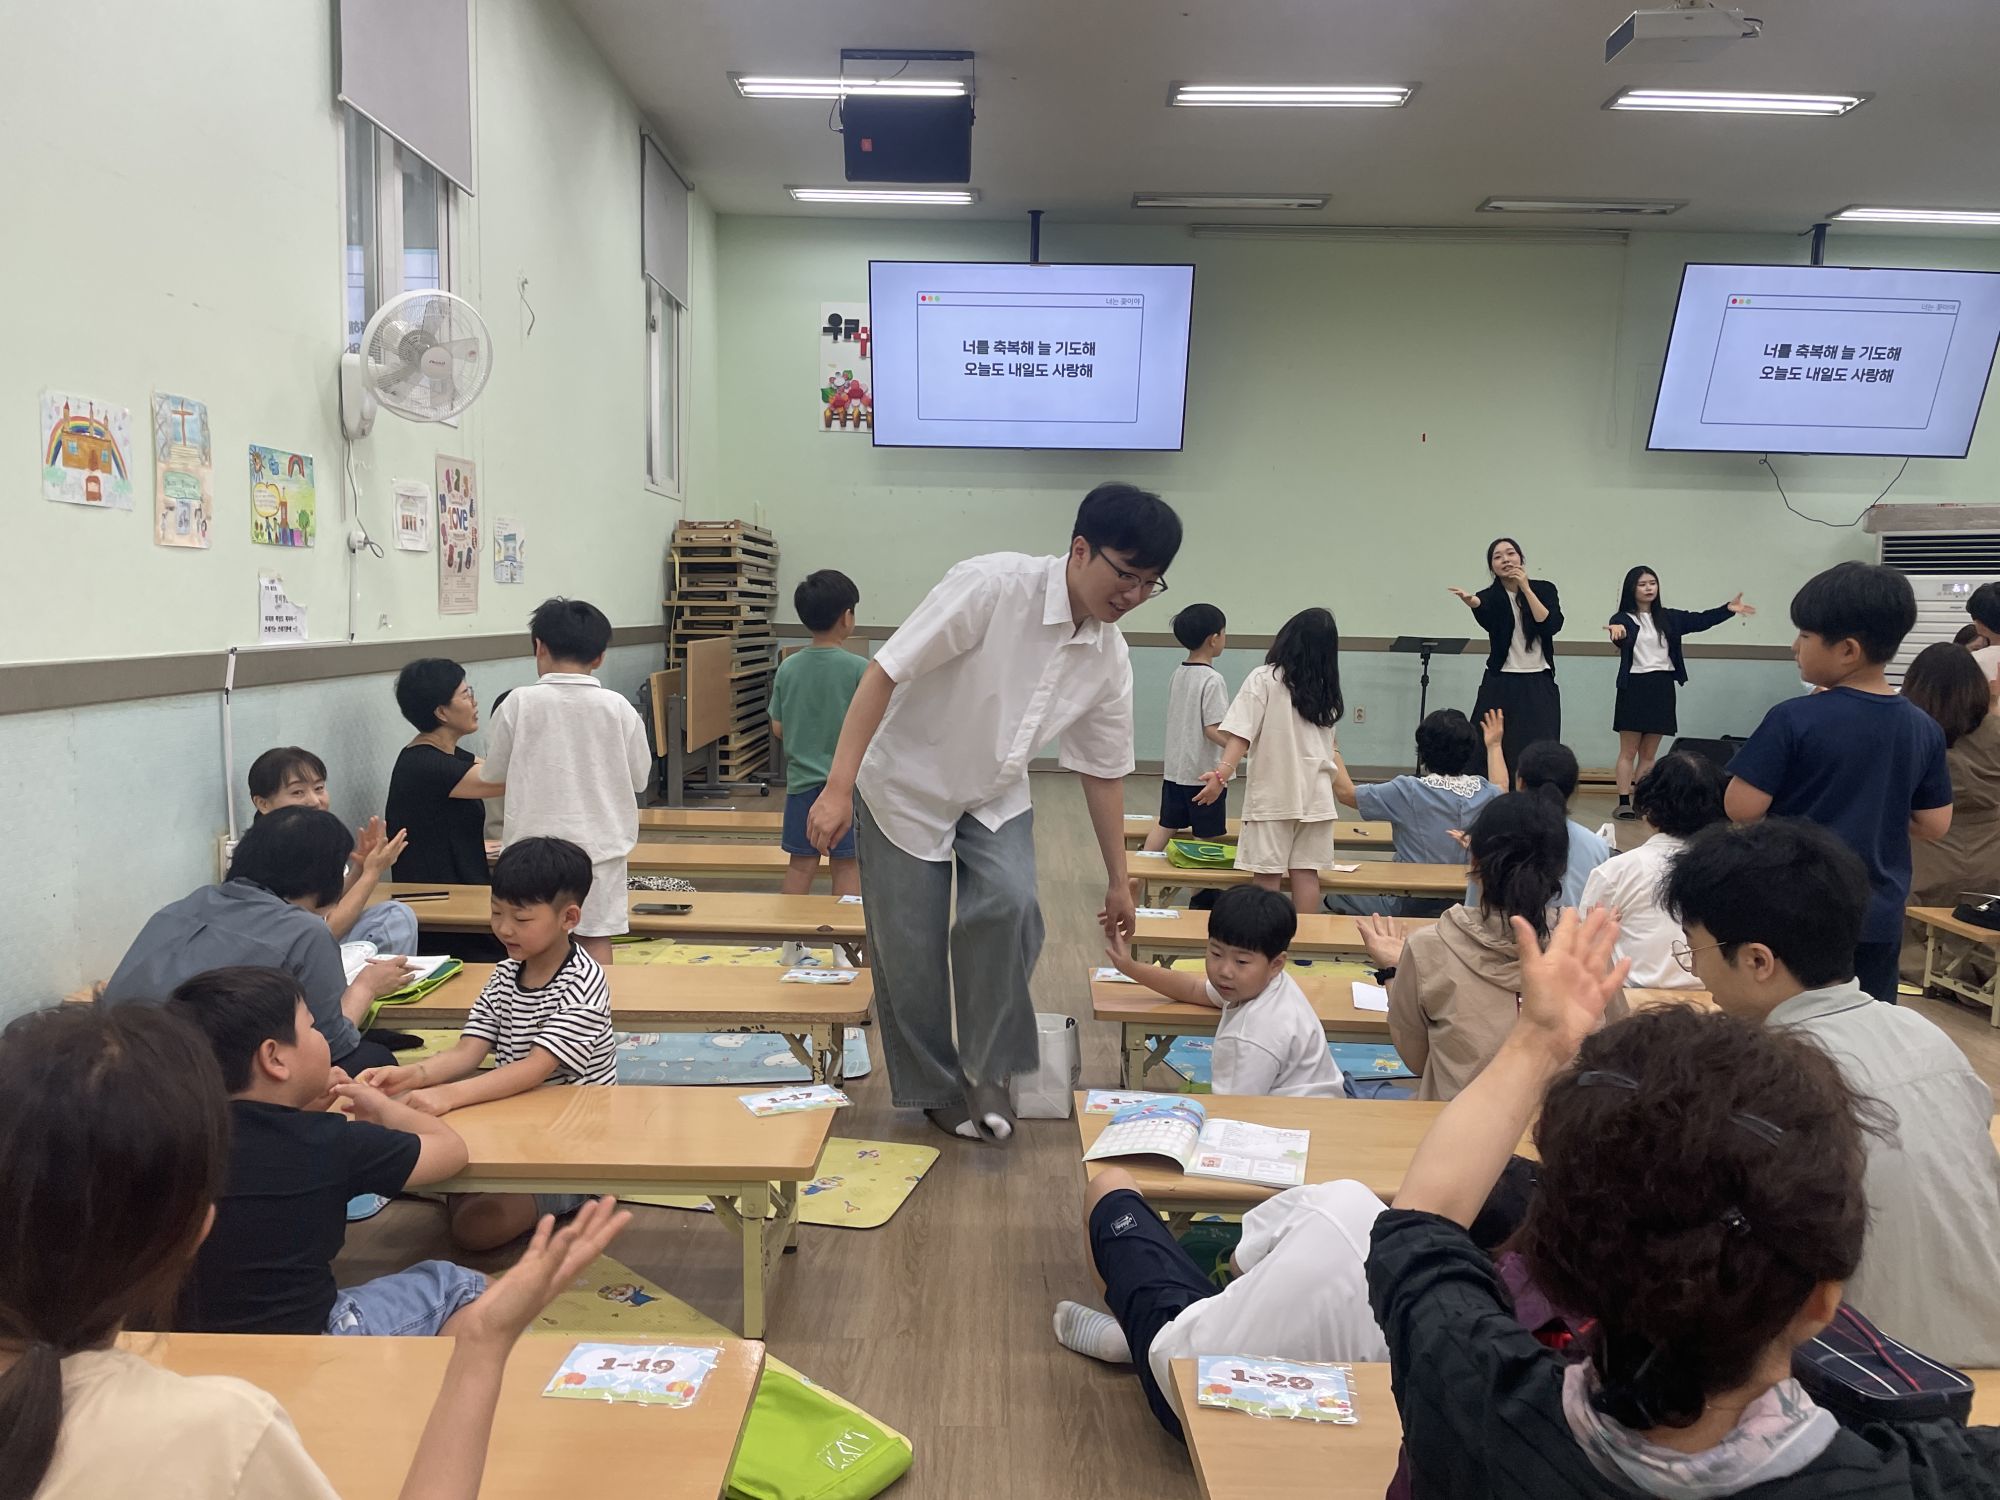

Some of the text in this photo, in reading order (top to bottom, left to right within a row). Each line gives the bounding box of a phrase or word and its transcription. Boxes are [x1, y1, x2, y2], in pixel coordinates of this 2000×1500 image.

[1105, 297, 1141, 306] 너는 꽃이야
[962, 339, 1097, 357] 너를 축복해 늘 기도해
[1763, 343, 1903, 362] 너를 축복해 늘 기도해
[963, 361, 1094, 379] 오늘도 내일도 사랑해
[1758, 365, 1895, 384] 오늘도 내일도 사랑해
[767, 1092, 813, 1104] 1-17
[596, 1357, 676, 1375] 1-19
[1230, 1369, 1315, 1391] 1-20
